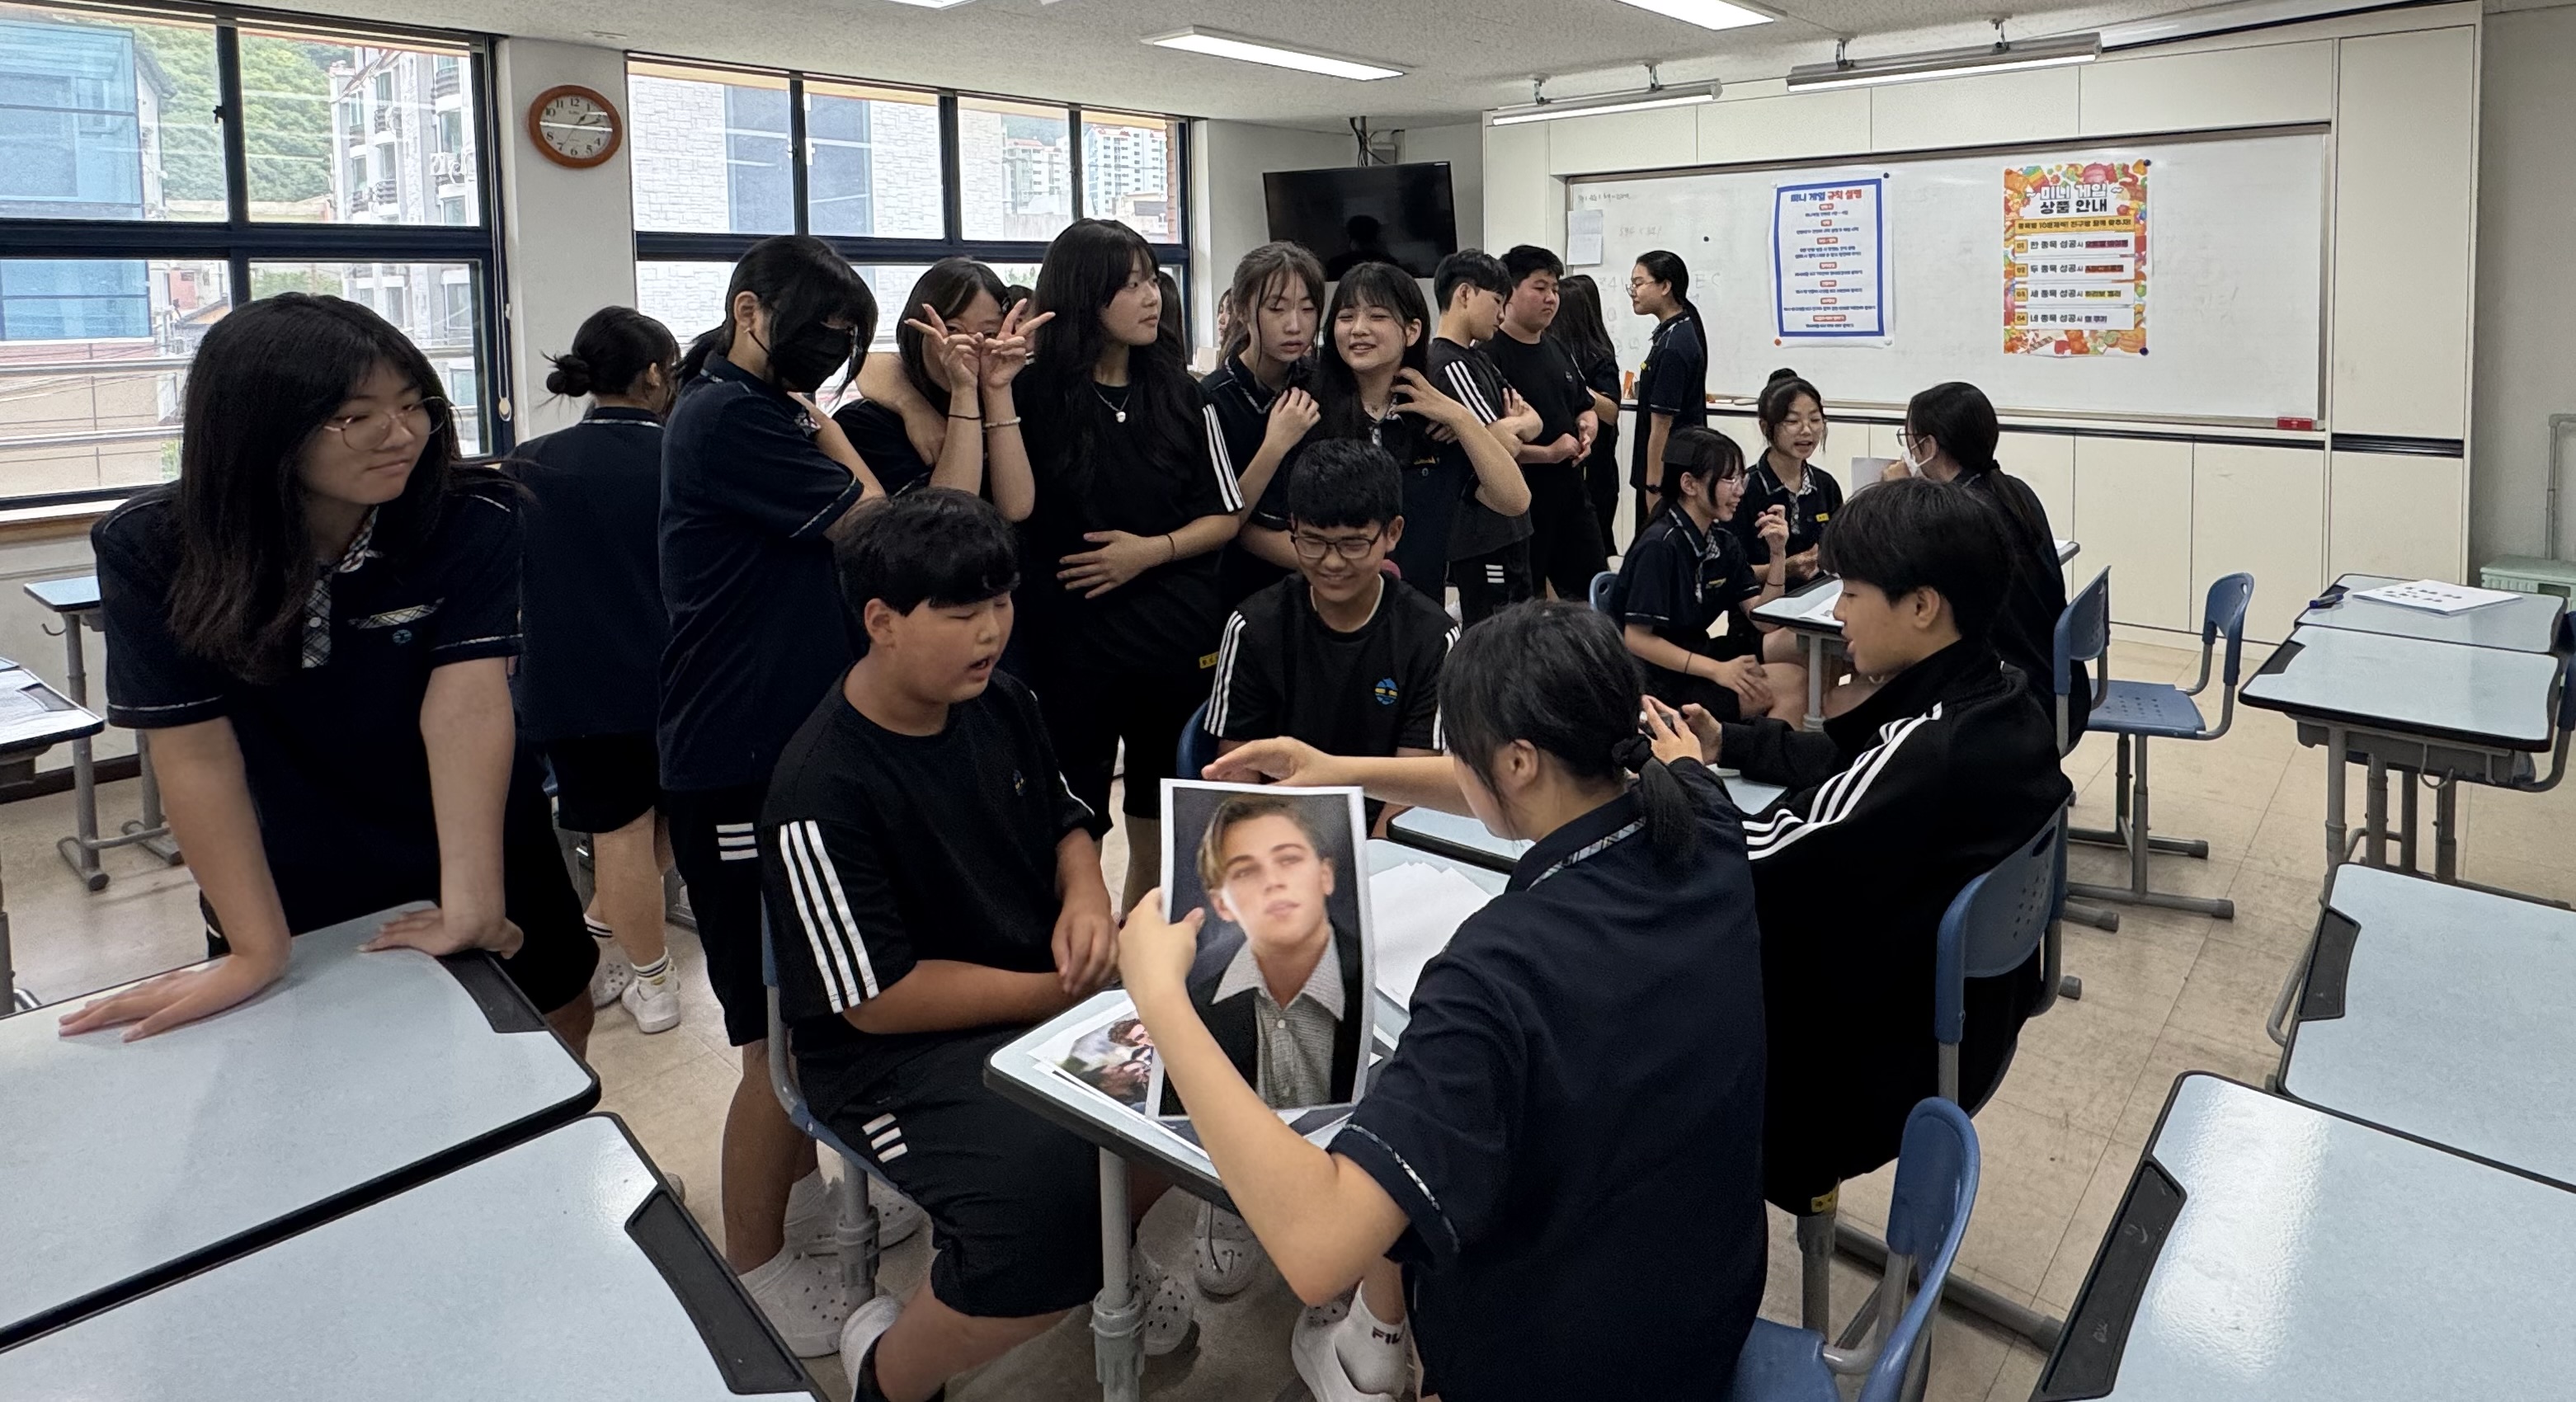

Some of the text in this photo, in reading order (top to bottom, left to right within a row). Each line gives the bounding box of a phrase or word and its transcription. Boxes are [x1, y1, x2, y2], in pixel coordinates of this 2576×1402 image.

[556, 99, 563, 108] 11
[571, 98, 580, 107] 12
[546, 108, 555, 116] 10
[546, 132, 553, 140] 8
[595, 138, 600, 146] 4
[557, 143, 563, 151] 7
[586, 145, 592, 154] 5
[2040, 185, 2071, 200] 미니
[2074, 182, 2107, 199] 게임
[1791, 192, 1806, 203] 미니
[1808, 191, 1825, 201] 게임
[1828, 190, 1844, 200] 규칙
[2041, 199, 2107, 214] 상품 안내
[2030, 241, 2039, 250] 한
[2041, 241, 2057, 249] 종목
[2030, 265, 2039, 273] 두
[2041, 264, 2057, 273] 종목
[2041, 289, 2057, 298] 종목
[2041, 314, 2057, 322] 종목
